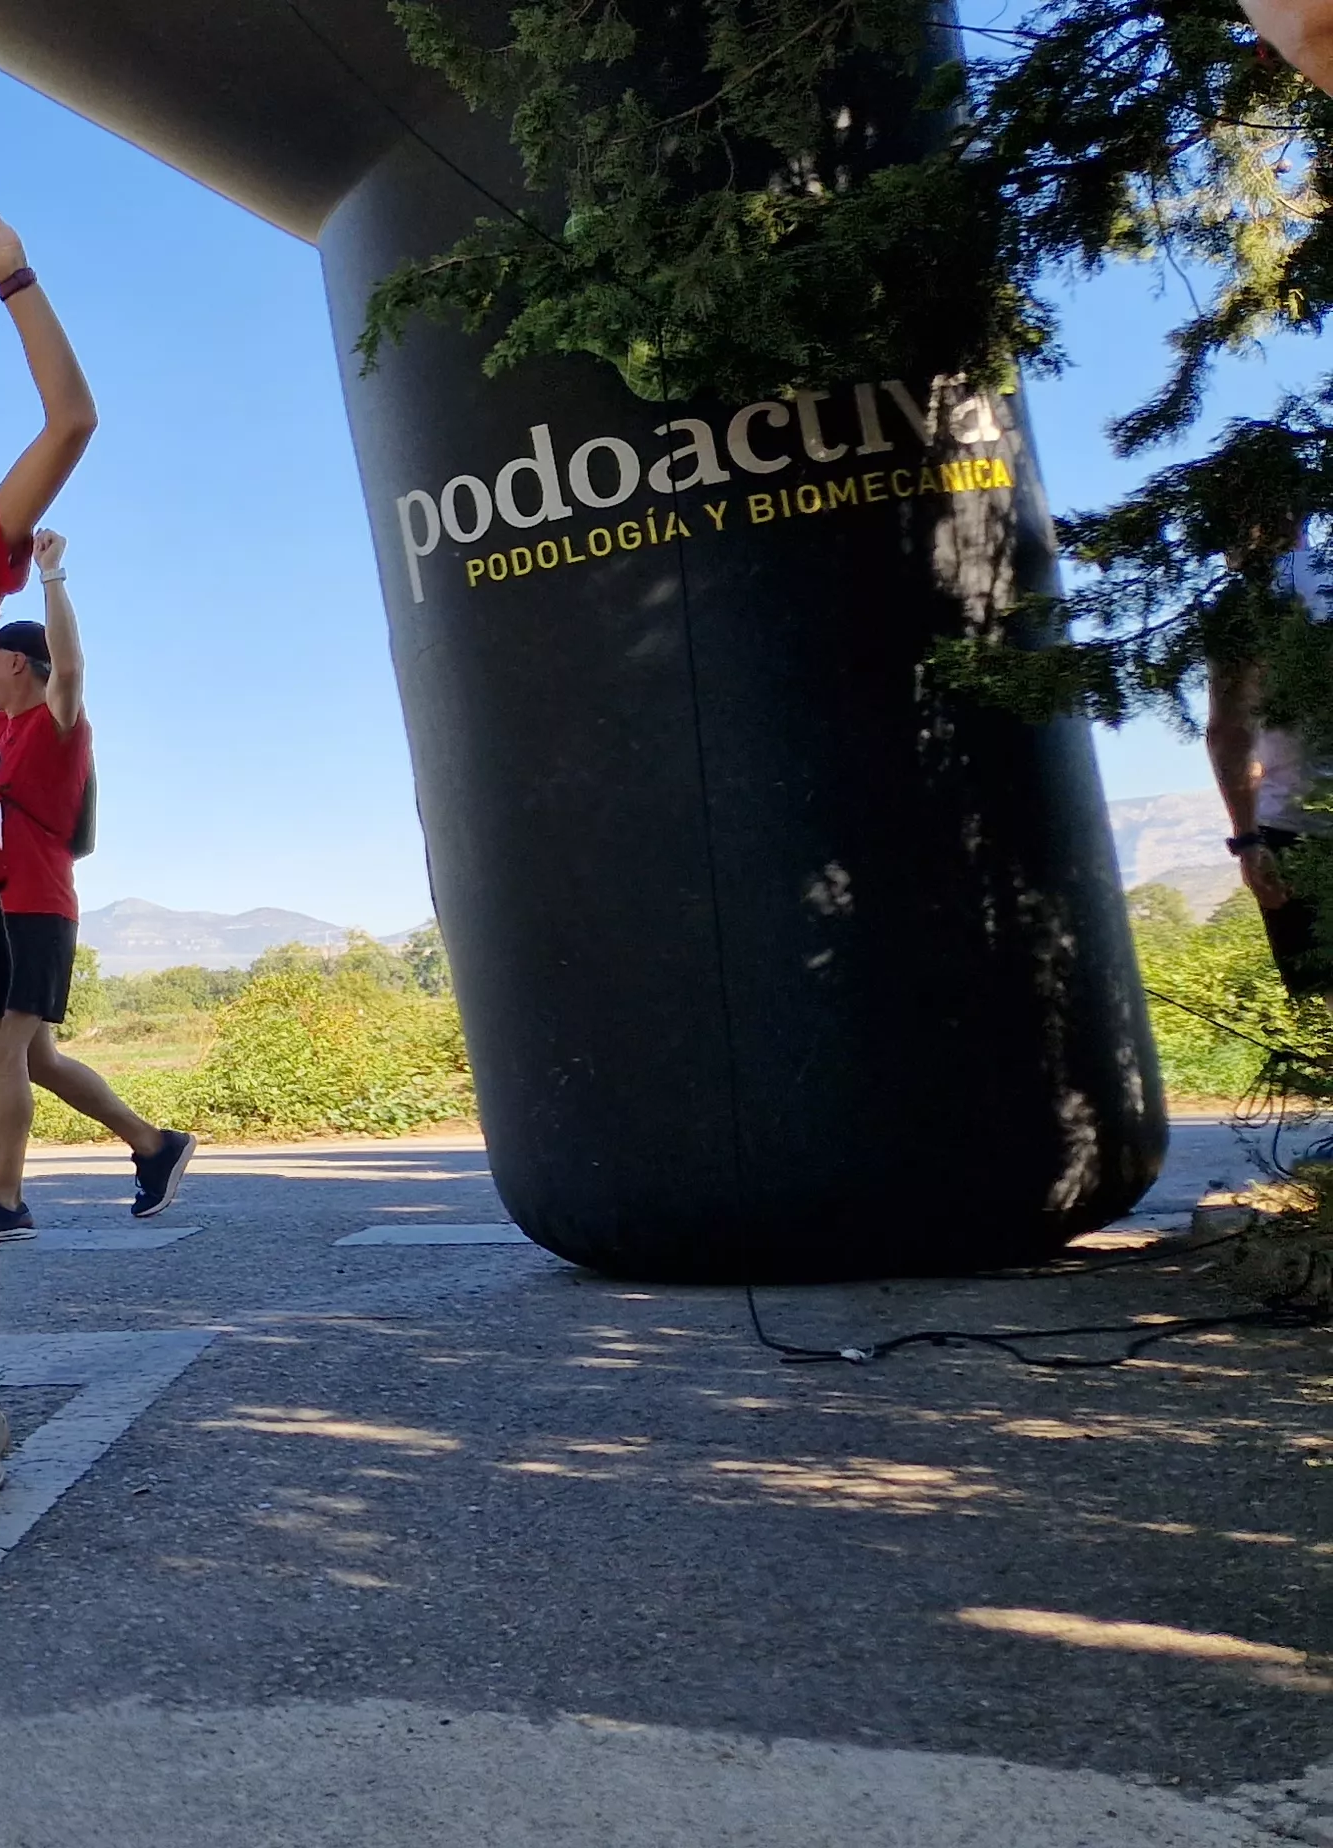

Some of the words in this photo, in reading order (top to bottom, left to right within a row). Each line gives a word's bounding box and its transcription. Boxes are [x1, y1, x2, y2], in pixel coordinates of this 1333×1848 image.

[396, 374, 1001, 603] podoactiva
[465, 507, 692, 588] PODOLOGÍA
[703, 501, 728, 531] Y
